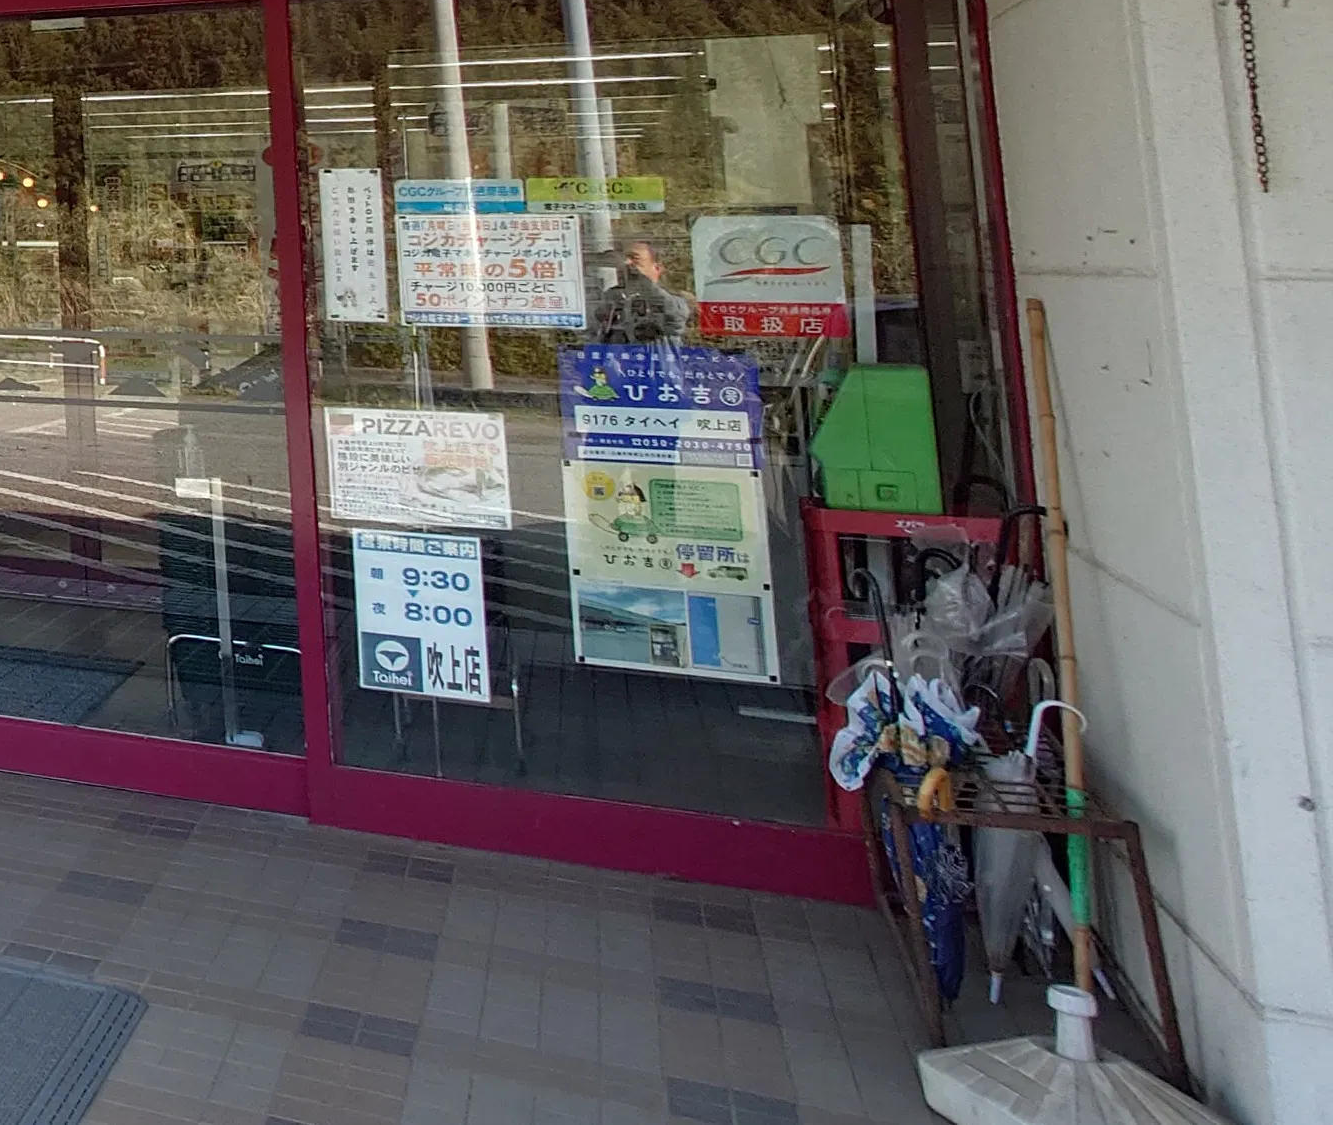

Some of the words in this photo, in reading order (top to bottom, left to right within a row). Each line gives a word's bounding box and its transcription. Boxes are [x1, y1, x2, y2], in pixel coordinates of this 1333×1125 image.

[718, 236, 826, 266] CGC
[722, 315, 825, 335] 取扱店
[361, 417, 500, 440] PIZZAREVO
[582, 414, 619, 427] 9176
[624, 416, 681, 429] タイヘイ
[696, 417, 742, 433] 吹上店
[359, 533, 477, 559] 営業時間ご案内
[675, 543, 751, 565] 停留所は
[401, 567, 470, 592] 9:30
[372, 602, 386, 615] 夜
[404, 602, 473, 627] 8:00
[372, 670, 414, 687] Taihei
[426, 642, 482, 695] 吹上店
